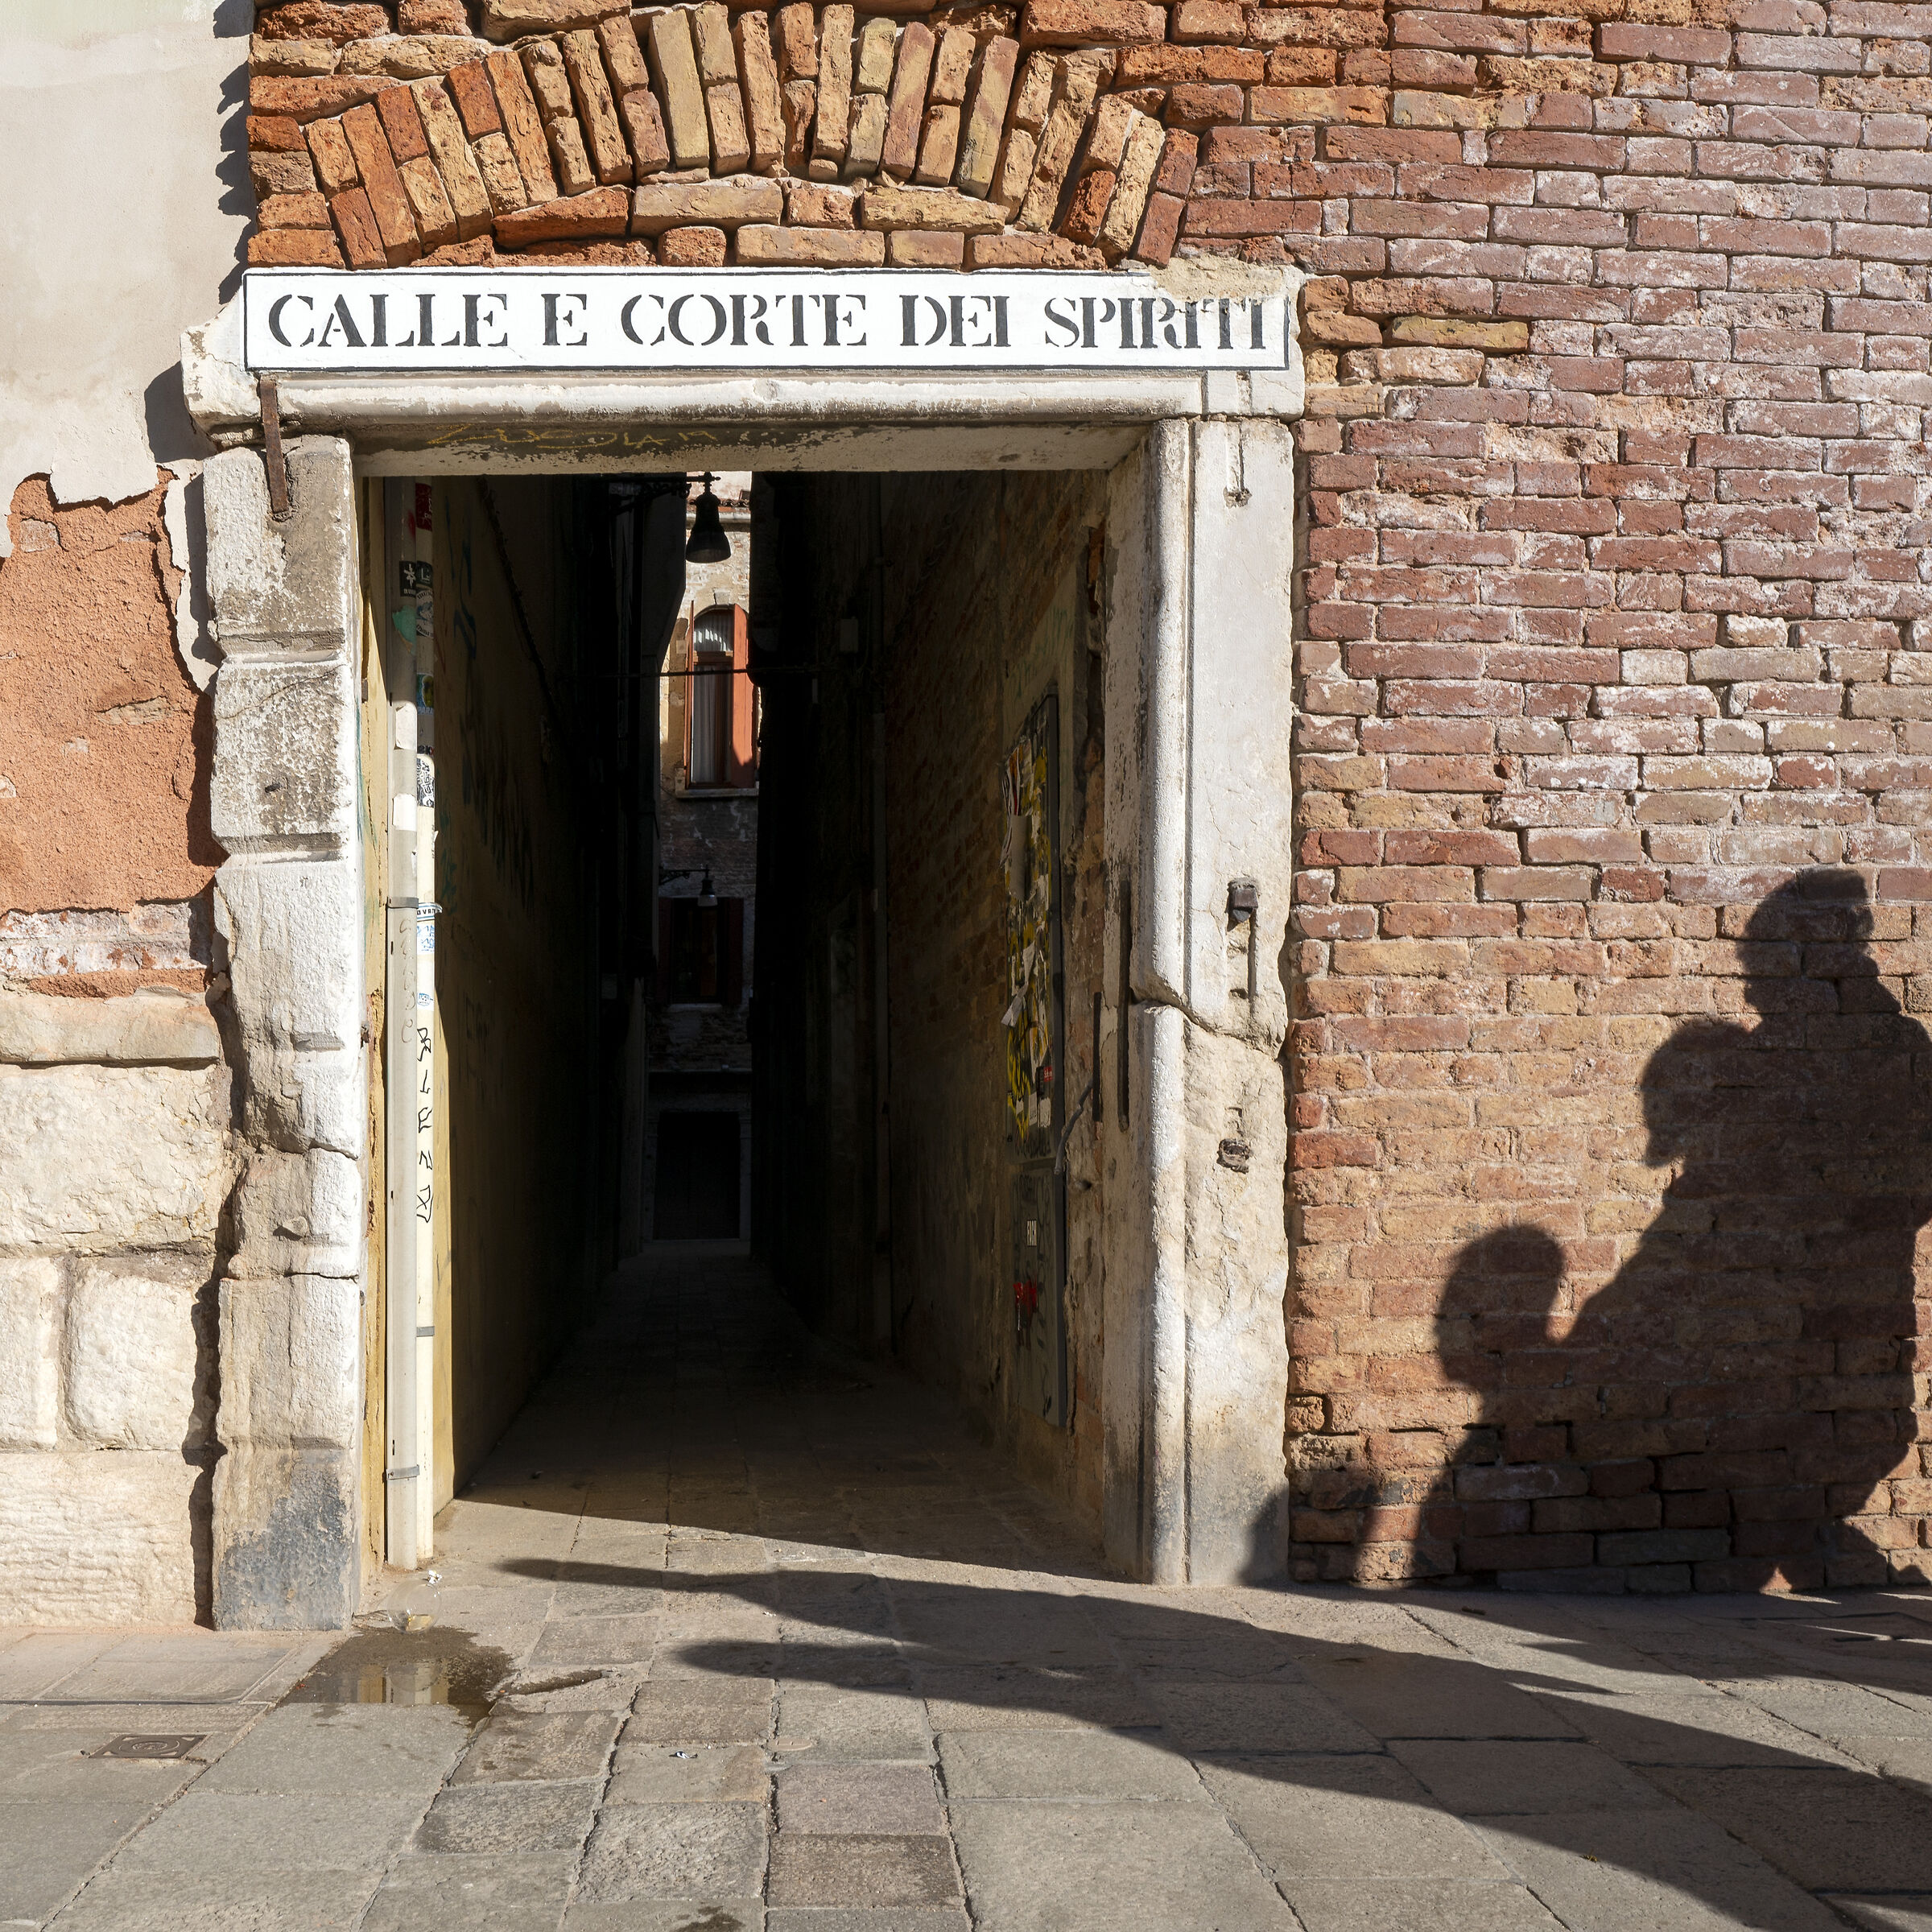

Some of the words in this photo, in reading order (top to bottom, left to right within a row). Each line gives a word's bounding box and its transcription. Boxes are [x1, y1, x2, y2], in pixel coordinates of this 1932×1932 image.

[268, 293, 508, 348] CALLE
[541, 293, 588, 347] E
[621, 294, 867, 347] CORTE
[898, 295, 1012, 348] DEI
[1044, 296, 1266, 349] SPIRITI
